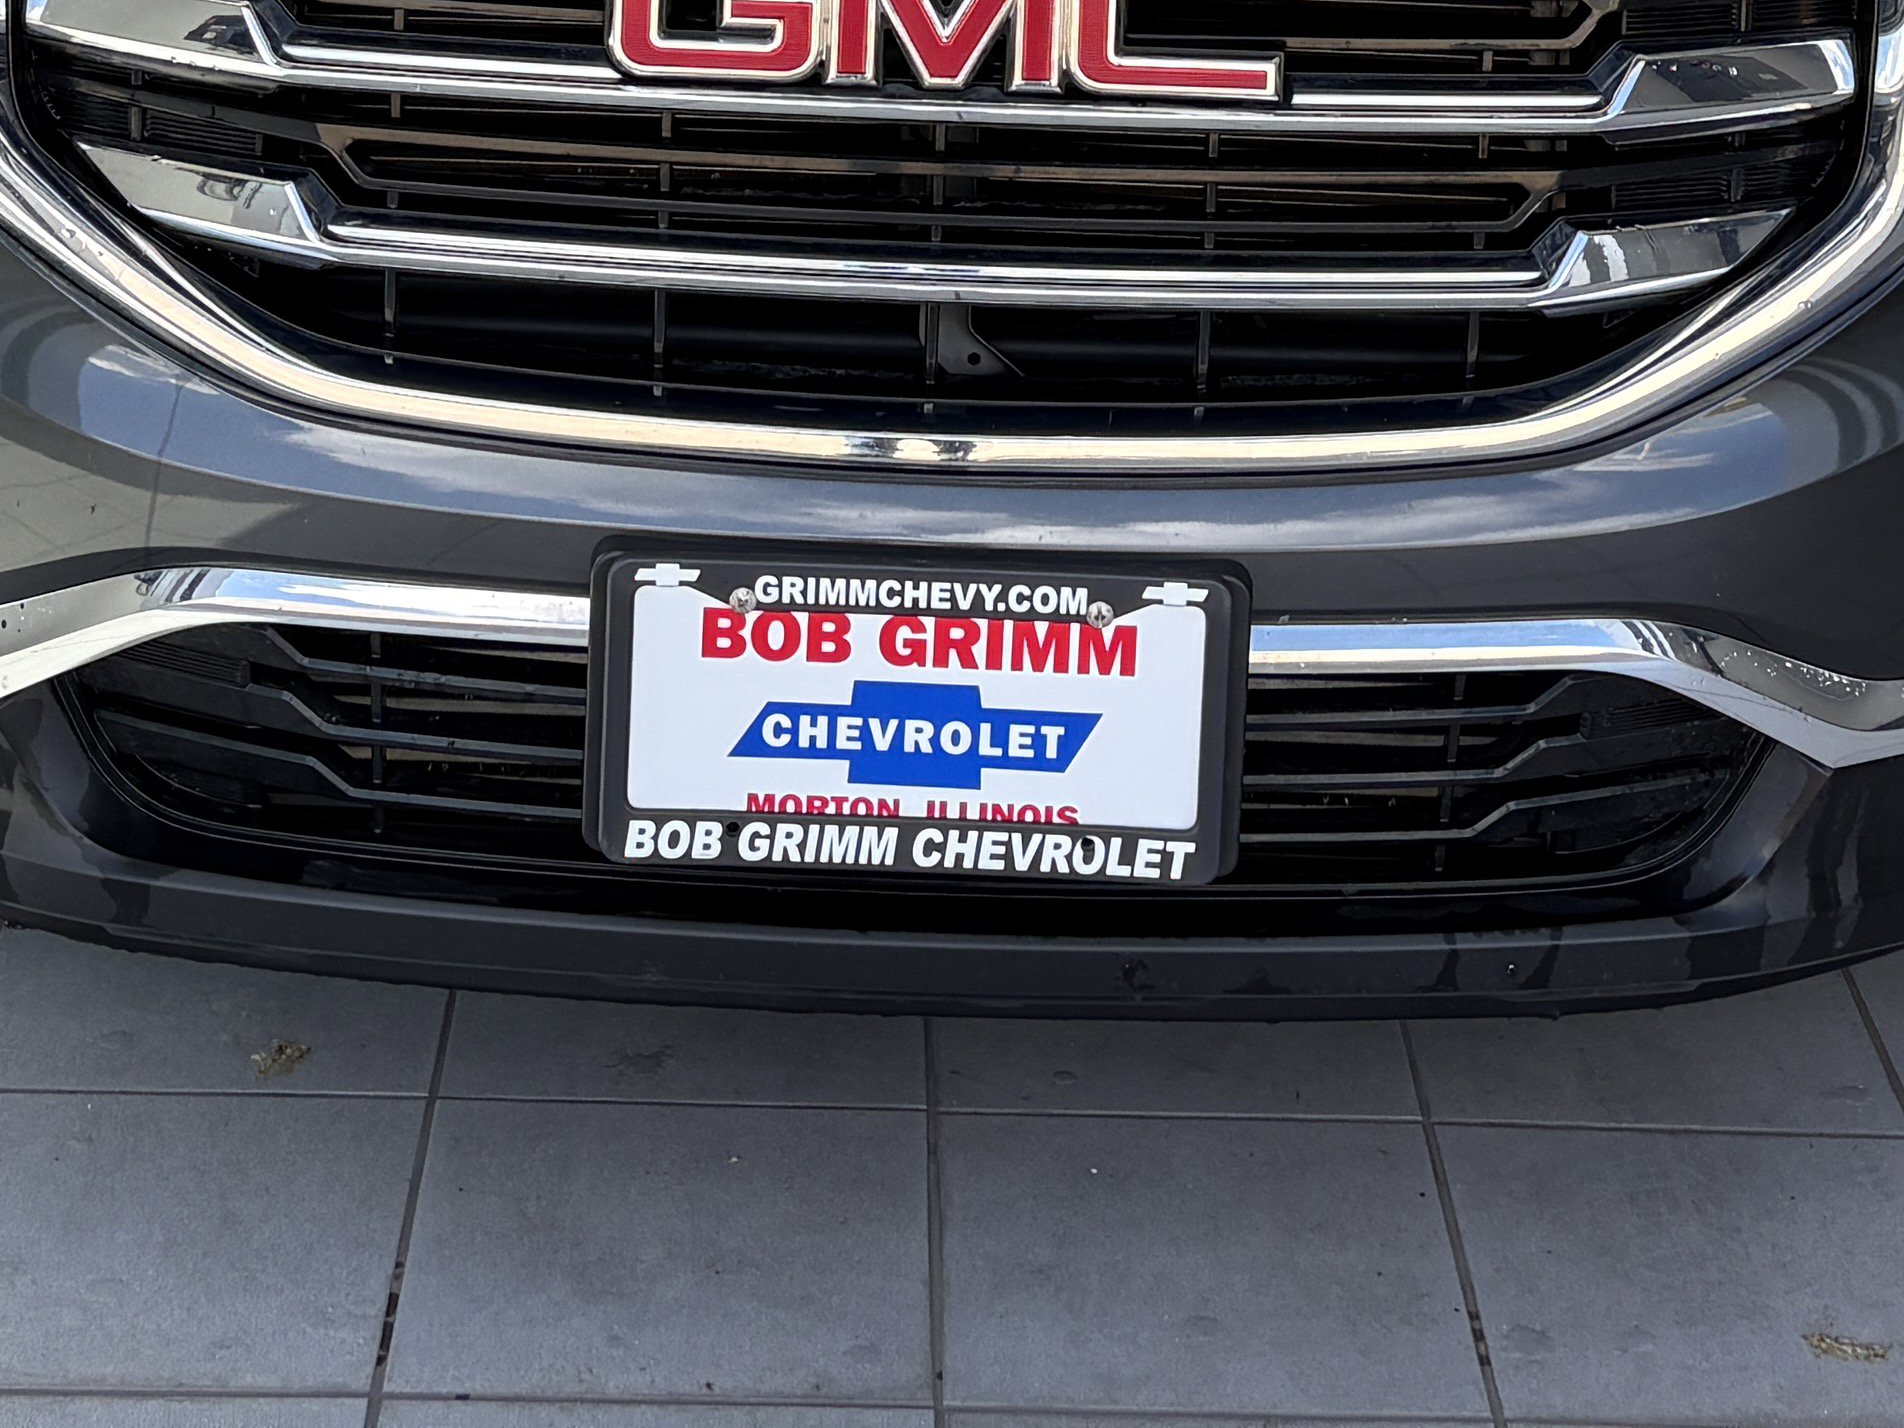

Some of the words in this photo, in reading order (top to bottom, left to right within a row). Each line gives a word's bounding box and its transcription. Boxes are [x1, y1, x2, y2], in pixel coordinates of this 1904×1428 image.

[755, 575, 1088, 616] GRIMMCHEVY.COM
[701, 608, 853, 662] BOB
[880, 616, 1137, 677] GRIMM
[761, 712, 1066, 760] CHEVROLET
[746, 793, 900, 817] MORTON
[927, 800, 1080, 825] ILLINOIS
[624, 819, 723, 860] BOB
[737, 822, 899, 866] GRIMM
[912, 829, 1196, 881] CHEVROLET
